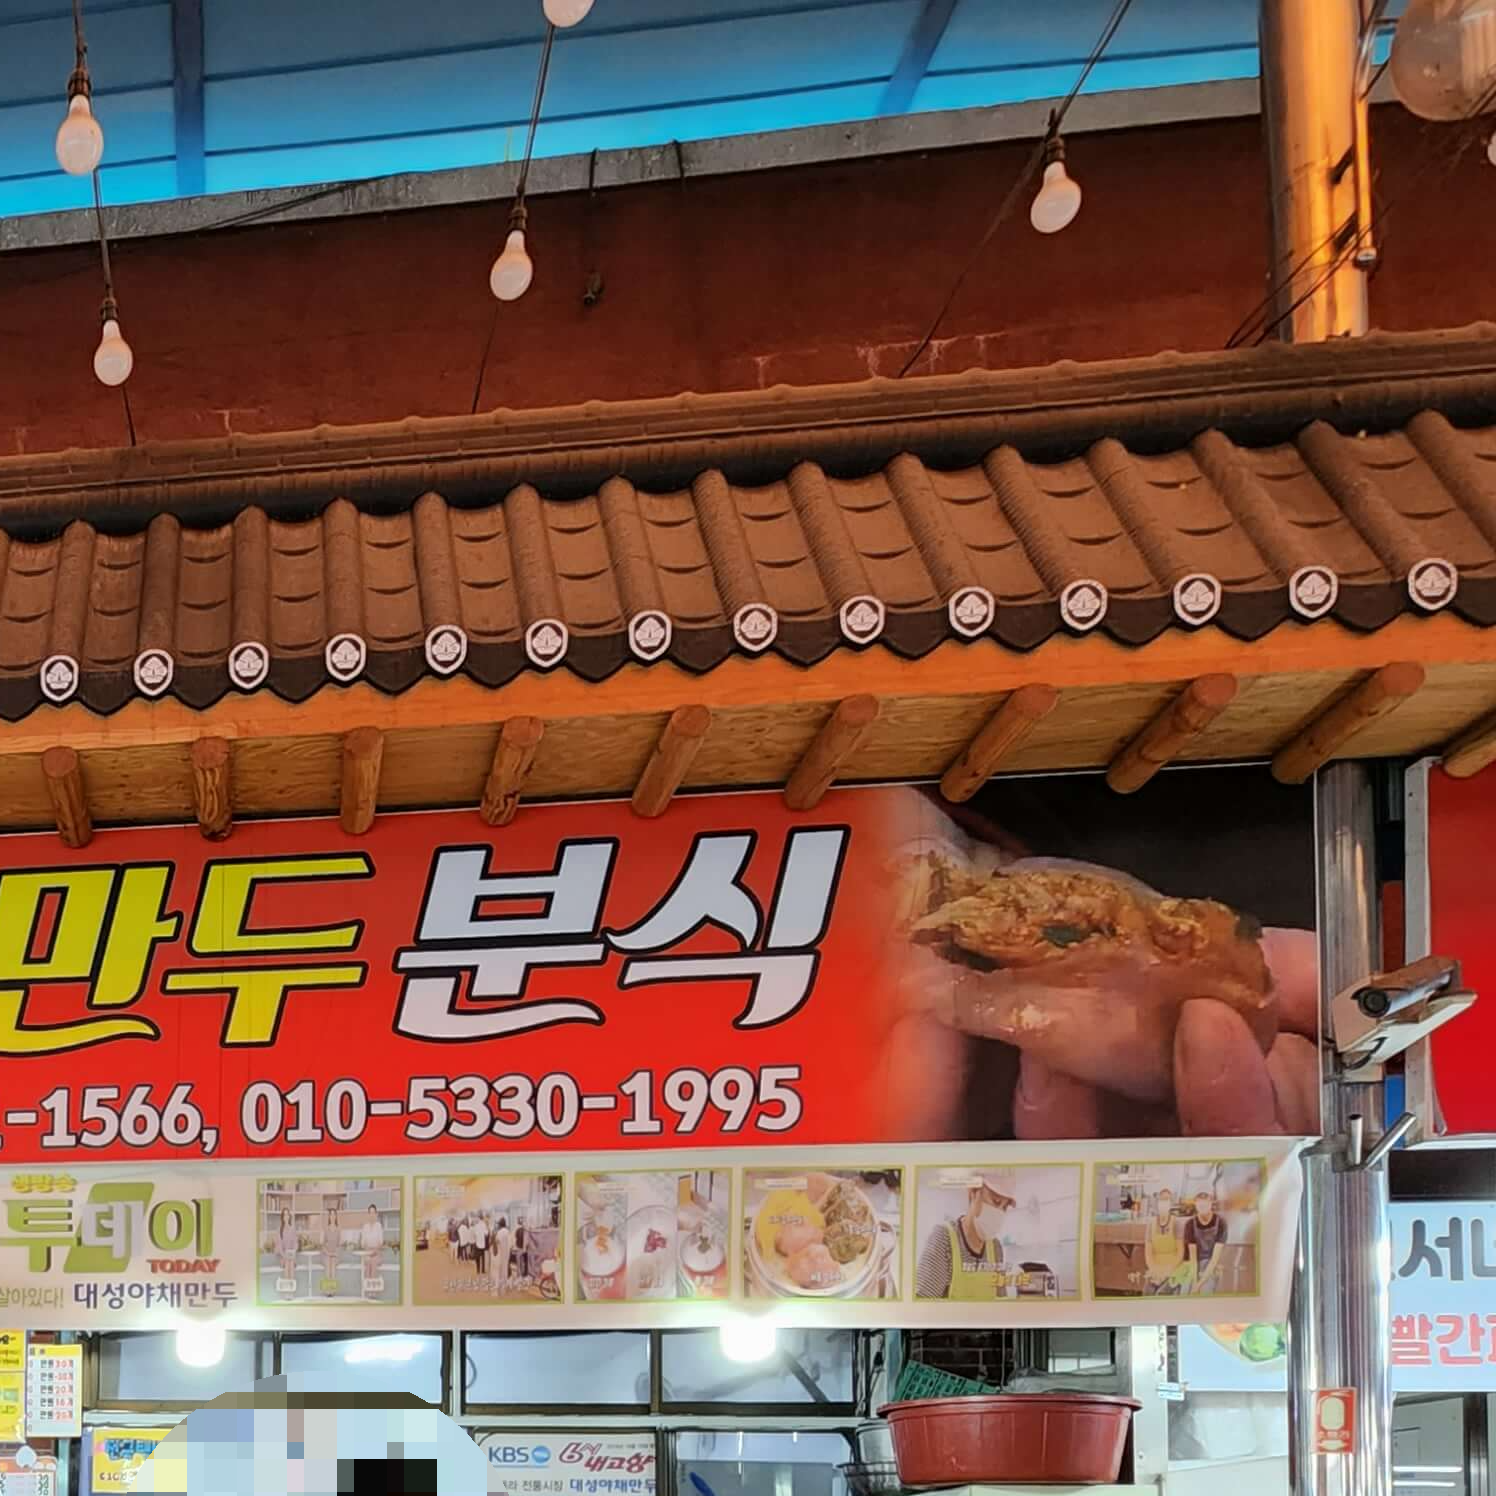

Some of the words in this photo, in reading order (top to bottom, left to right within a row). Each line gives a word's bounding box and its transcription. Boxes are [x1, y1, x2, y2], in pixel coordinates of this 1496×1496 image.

[393, 826, 850, 1041] 분식
[240, 1065, 801, 1143] 010-5330-1995
[11, 1173, 77, 1193] 생방송
[146, 1259, 221, 1274] TODAY
[74, 1281, 238, 1310] 대성야채만두
[1392, 1313, 1496, 1365] 빨간
[488, 1446, 529, 1463] KBS
[584, 1452, 656, 1473] 내고향
[522, 1480, 563, 1492] 전통시장
